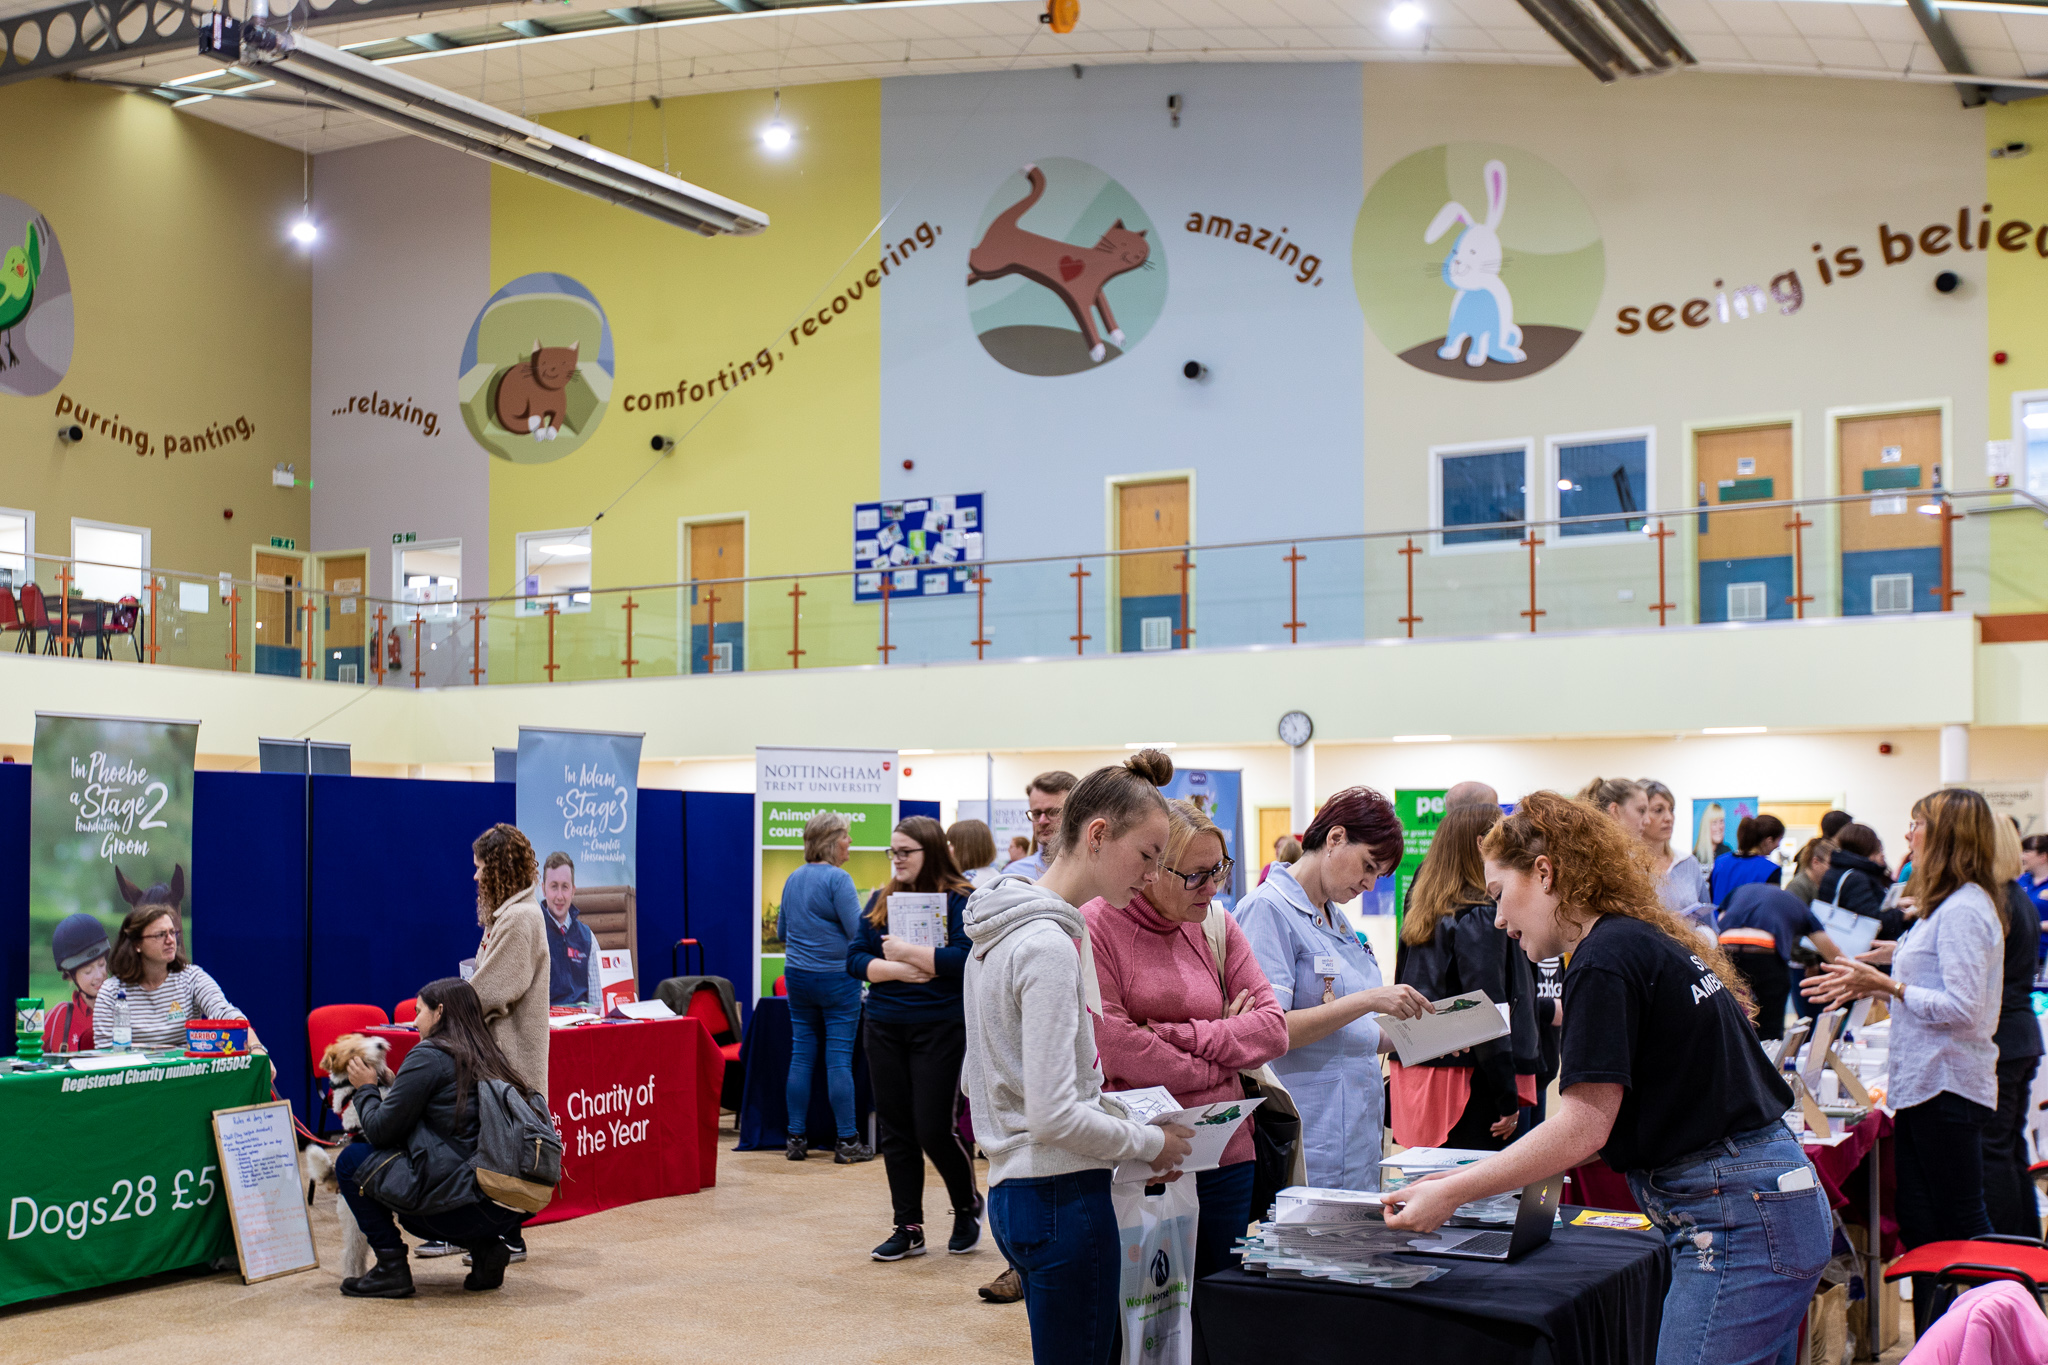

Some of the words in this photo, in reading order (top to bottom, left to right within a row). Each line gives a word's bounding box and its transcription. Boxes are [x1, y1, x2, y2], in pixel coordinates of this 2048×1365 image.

[1185, 211, 1324, 287] amazing,
[1616, 268, 1806, 336] seeing
[1811, 241, 1866, 288] is
[623, 347, 785, 413] comforting,
[789, 220, 944, 347] recovering,
[55, 393, 155, 457] purring,
[163, 415, 256, 460] panting,
[332, 389, 441, 437] ...relaxing,
[71, 755, 88, 779] I'm
[89, 751, 149, 786] Phoebe
[564, 764, 577, 784] I'm
[579, 762, 617, 789] Adam
[765, 764, 881, 780] NOTTINGHAM
[764, 781, 805, 792] TRENT
[809, 782, 882, 793] UNIVERSITY
[69, 791, 81, 806] a
[80, 782, 149, 835] Stage
[138, 781, 170, 831] 2
[75, 815, 121, 834] Foundation
[556, 795, 565, 807] a
[562, 788, 619, 834] Stage
[608, 786, 629, 834] 3
[769, 808, 815, 822] Animal
[100, 832, 150, 863] Groom
[564, 819, 599, 840] Coach
[590, 838, 621, 853] Complete
[580, 850, 627, 866] Horsemanship
[190, 1031, 217, 1041] HARIBO
[61, 1070, 123, 1093] Registered
[124, 1066, 164, 1083] Charity
[165, 1061, 209, 1079] number:
[210, 1055, 252, 1072] 1155042
[567, 1083, 633, 1122] Charity
[636, 1074, 655, 1106] of
[577, 1125, 606, 1157] the
[608, 1119, 650, 1148] Year
[8, 1175, 157, 1240] Dogs28
[171, 1165, 216, 1211] £5
